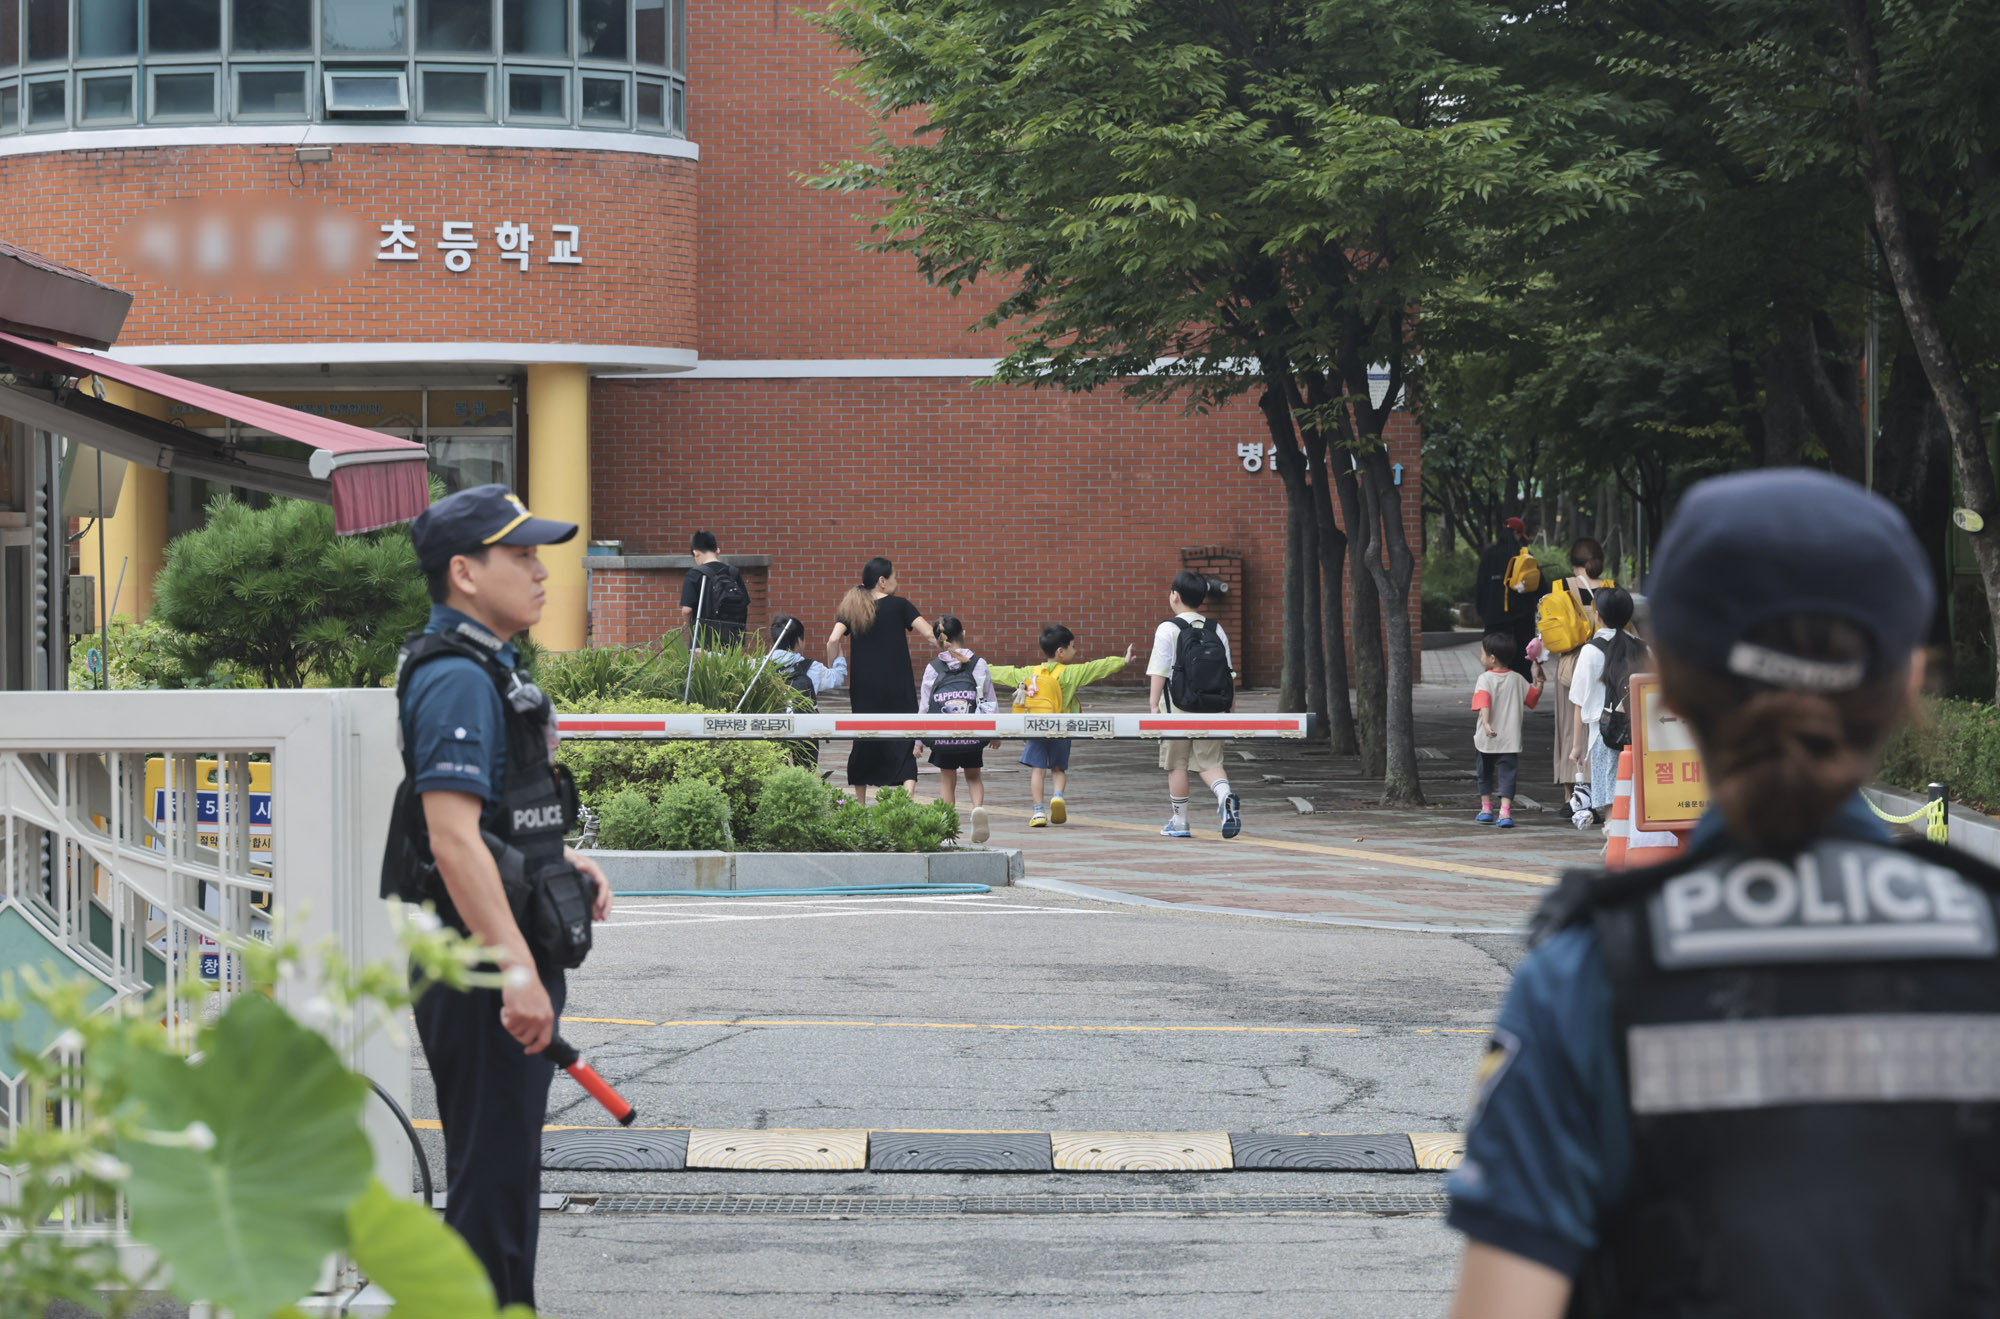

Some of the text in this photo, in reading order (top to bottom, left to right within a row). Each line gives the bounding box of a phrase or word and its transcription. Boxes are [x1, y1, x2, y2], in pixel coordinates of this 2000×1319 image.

[377, 219, 583, 273] 초등학교
[706, 718, 791, 732] 외부차량 출입금지
[1027, 719, 1111, 732] 자전거 출입금지
[513, 804, 564, 831] POLICE
[1665, 854, 1979, 931] POLICE
